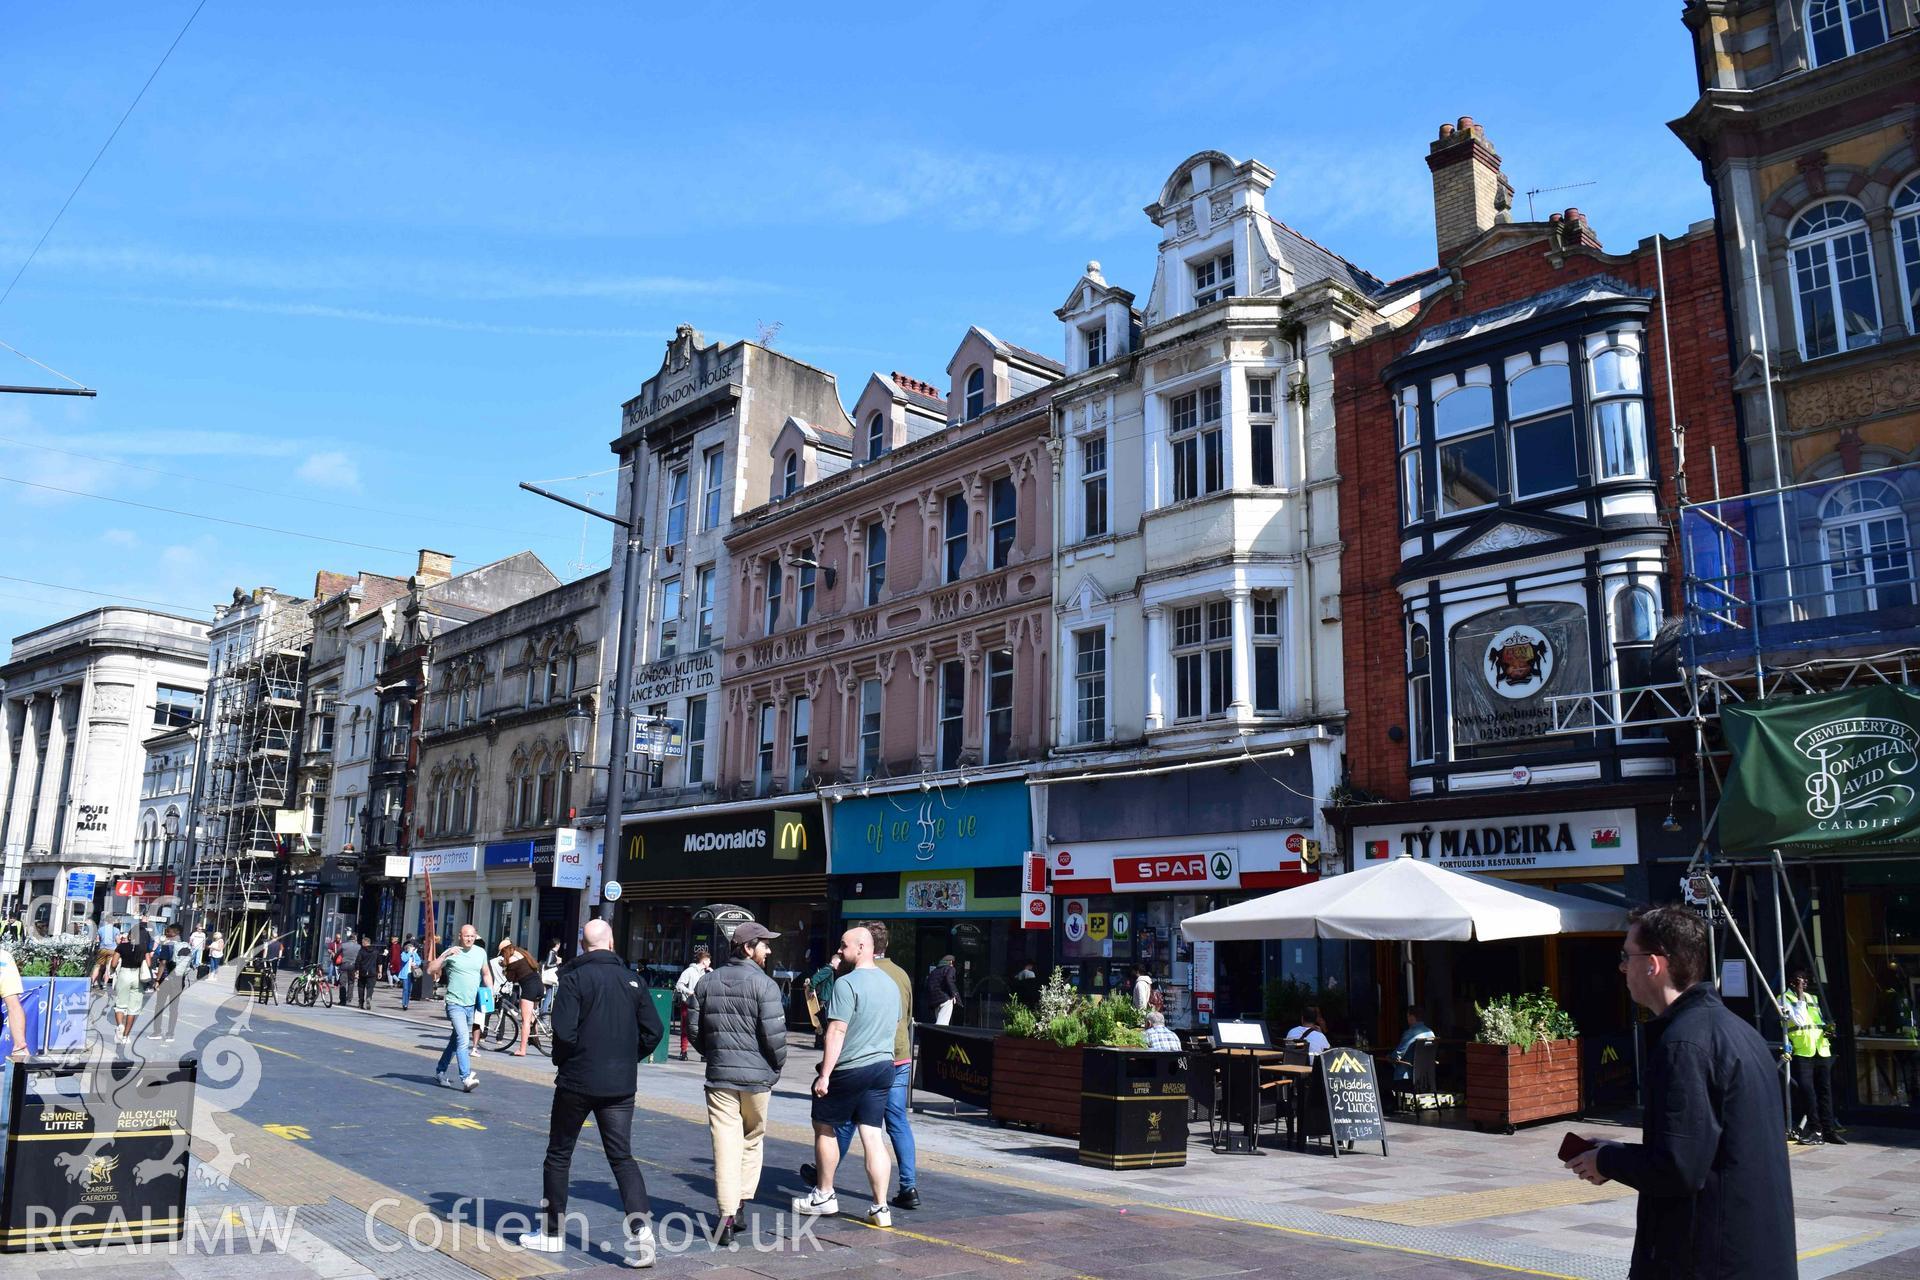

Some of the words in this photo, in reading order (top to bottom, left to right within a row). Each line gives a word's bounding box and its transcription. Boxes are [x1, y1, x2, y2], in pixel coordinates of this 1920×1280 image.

[629, 404, 655, 426] ROYAL
[657, 380, 697, 411] LONDON
[636, 665, 671, 686] LONDON
[675, 654, 714, 676] MUTUAL
[655, 677, 694, 698] SOCIETY
[696, 673, 714, 688] LTD.
[1807, 721, 1889, 746] JEWELLERY
[1890, 724, 1911, 738] BY
[79, 804, 109, 815] HOUSE
[85, 814, 98, 822] OF
[1270, 817, 1284, 826] Mary
[1818, 817, 1902, 830] CARDIFF
[76, 821, 107, 832] FRASER
[684, 828, 767, 852] McDonald's
[1440, 823, 1577, 857] MADEIRA
[421, 854, 442, 867] TESCO
[561, 853, 580, 864] red
[1440, 859, 1485, 868] PORTUGUESE
[1488, 857, 1537, 866] RESTAURANT
[1138, 859, 1205, 878] SPAR
[694, 943, 708, 953] cash
[1340, 1078, 1373, 1090] Madeira
[1333, 1093, 1344, 1111] 2
[118, 1110, 178, 1120] AILGYLCHU
[45, 1121, 84, 1130] LITTER
[117, 1118, 178, 1128] RECYCLING
[85, 1185, 114, 1193] CARDIFF
[80, 1193, 118, 1202] CAERDYDD
